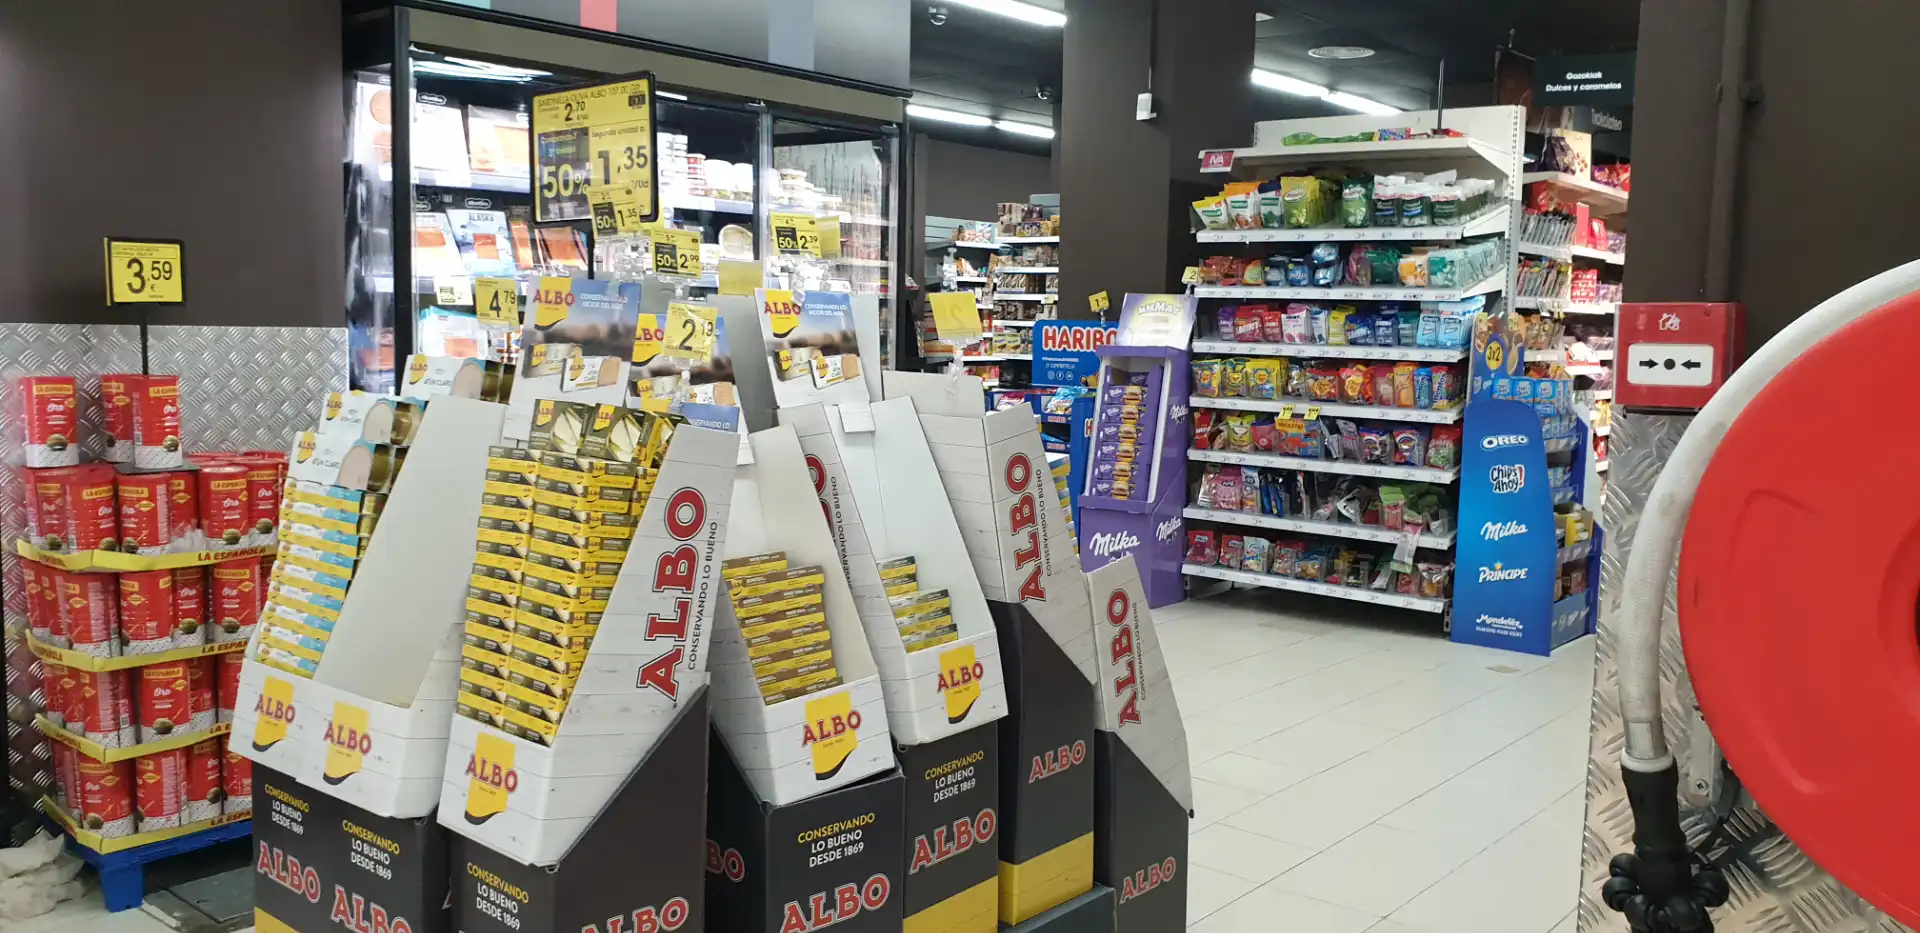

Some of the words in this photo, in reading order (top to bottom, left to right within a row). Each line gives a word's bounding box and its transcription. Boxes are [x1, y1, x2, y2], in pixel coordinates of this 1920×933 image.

[1546, 84, 1571, 92] Dulces
[1573, 84, 1578, 92] y
[1580, 82, 1621, 91] caramelos
[1566, 71, 1602, 80] Gazokiak
[542, 164, 589, 199] 50%
[533, 289, 576, 306] ALBO
[764, 300, 802, 317] ALBO
[1482, 435, 1529, 449] OREO
[1035, 469, 1044, 499] BUENO
[1490, 465, 1518, 481] Chips
[830, 476, 841, 511] BUENO
[705, 521, 718, 562] BUENO
[1005, 452, 1047, 603] ALBO
[1089, 530, 1140, 556] Milka
[1156, 516, 1181, 541] Milka
[1480, 520, 1529, 541] Milka
[198, 551, 211, 561] LA
[1040, 514, 1052, 577] CONSERVANDO
[702, 564, 711, 580] LO
[636, 486, 707, 701] ALBO
[688, 581, 708, 670] CONSERVANDO
[1107, 588, 1141, 728] ALBO
[936, 661, 984, 694] ALBO
[254, 693, 296, 724] ALBO
[323, 720, 372, 755] ALBO
[801, 710, 862, 748] ALBO
[464, 753, 519, 793] ALBO
[924, 750, 984, 781] CONSERVANDO
[1028, 739, 1087, 784] ALBO
[933, 785, 959, 803] DESDE
[959, 778, 976, 794] 1869
[935, 776, 946, 789] LO
[947, 767, 975, 786] BUENO
[264, 784, 310, 813] CONSERVANDO
[272, 799, 281, 811] LO
[281, 804, 303, 822] BUENO
[271, 811, 291, 829] DESDE
[291, 820, 304, 836] 1869
[342, 820, 400, 856] CONSERVANDO
[797, 812, 875, 844] CONSERVANDO
[352, 838, 362, 851] LO
[363, 844, 390, 865] BUENO
[809, 849, 842, 868] DESDE
[843, 842, 864, 859] 1869
[811, 838, 825, 854] LO
[828, 830, 863, 849] BUENO
[908, 808, 996, 875] ALBO
[257, 841, 321, 904] ALBO
[351, 852, 376, 873] DESDE
[376, 864, 392, 880] 1869
[705, 839, 745, 882] BO
[467, 862, 529, 904] CONSERVANDO
[1119, 855, 1177, 905] ALBO
[476, 896, 503, 923] DESDE
[503, 908, 520, 930] 1869
[477, 882, 488, 897] LO
[488, 887, 518, 914] BUENO
[780, 872, 891, 933] ALBO
